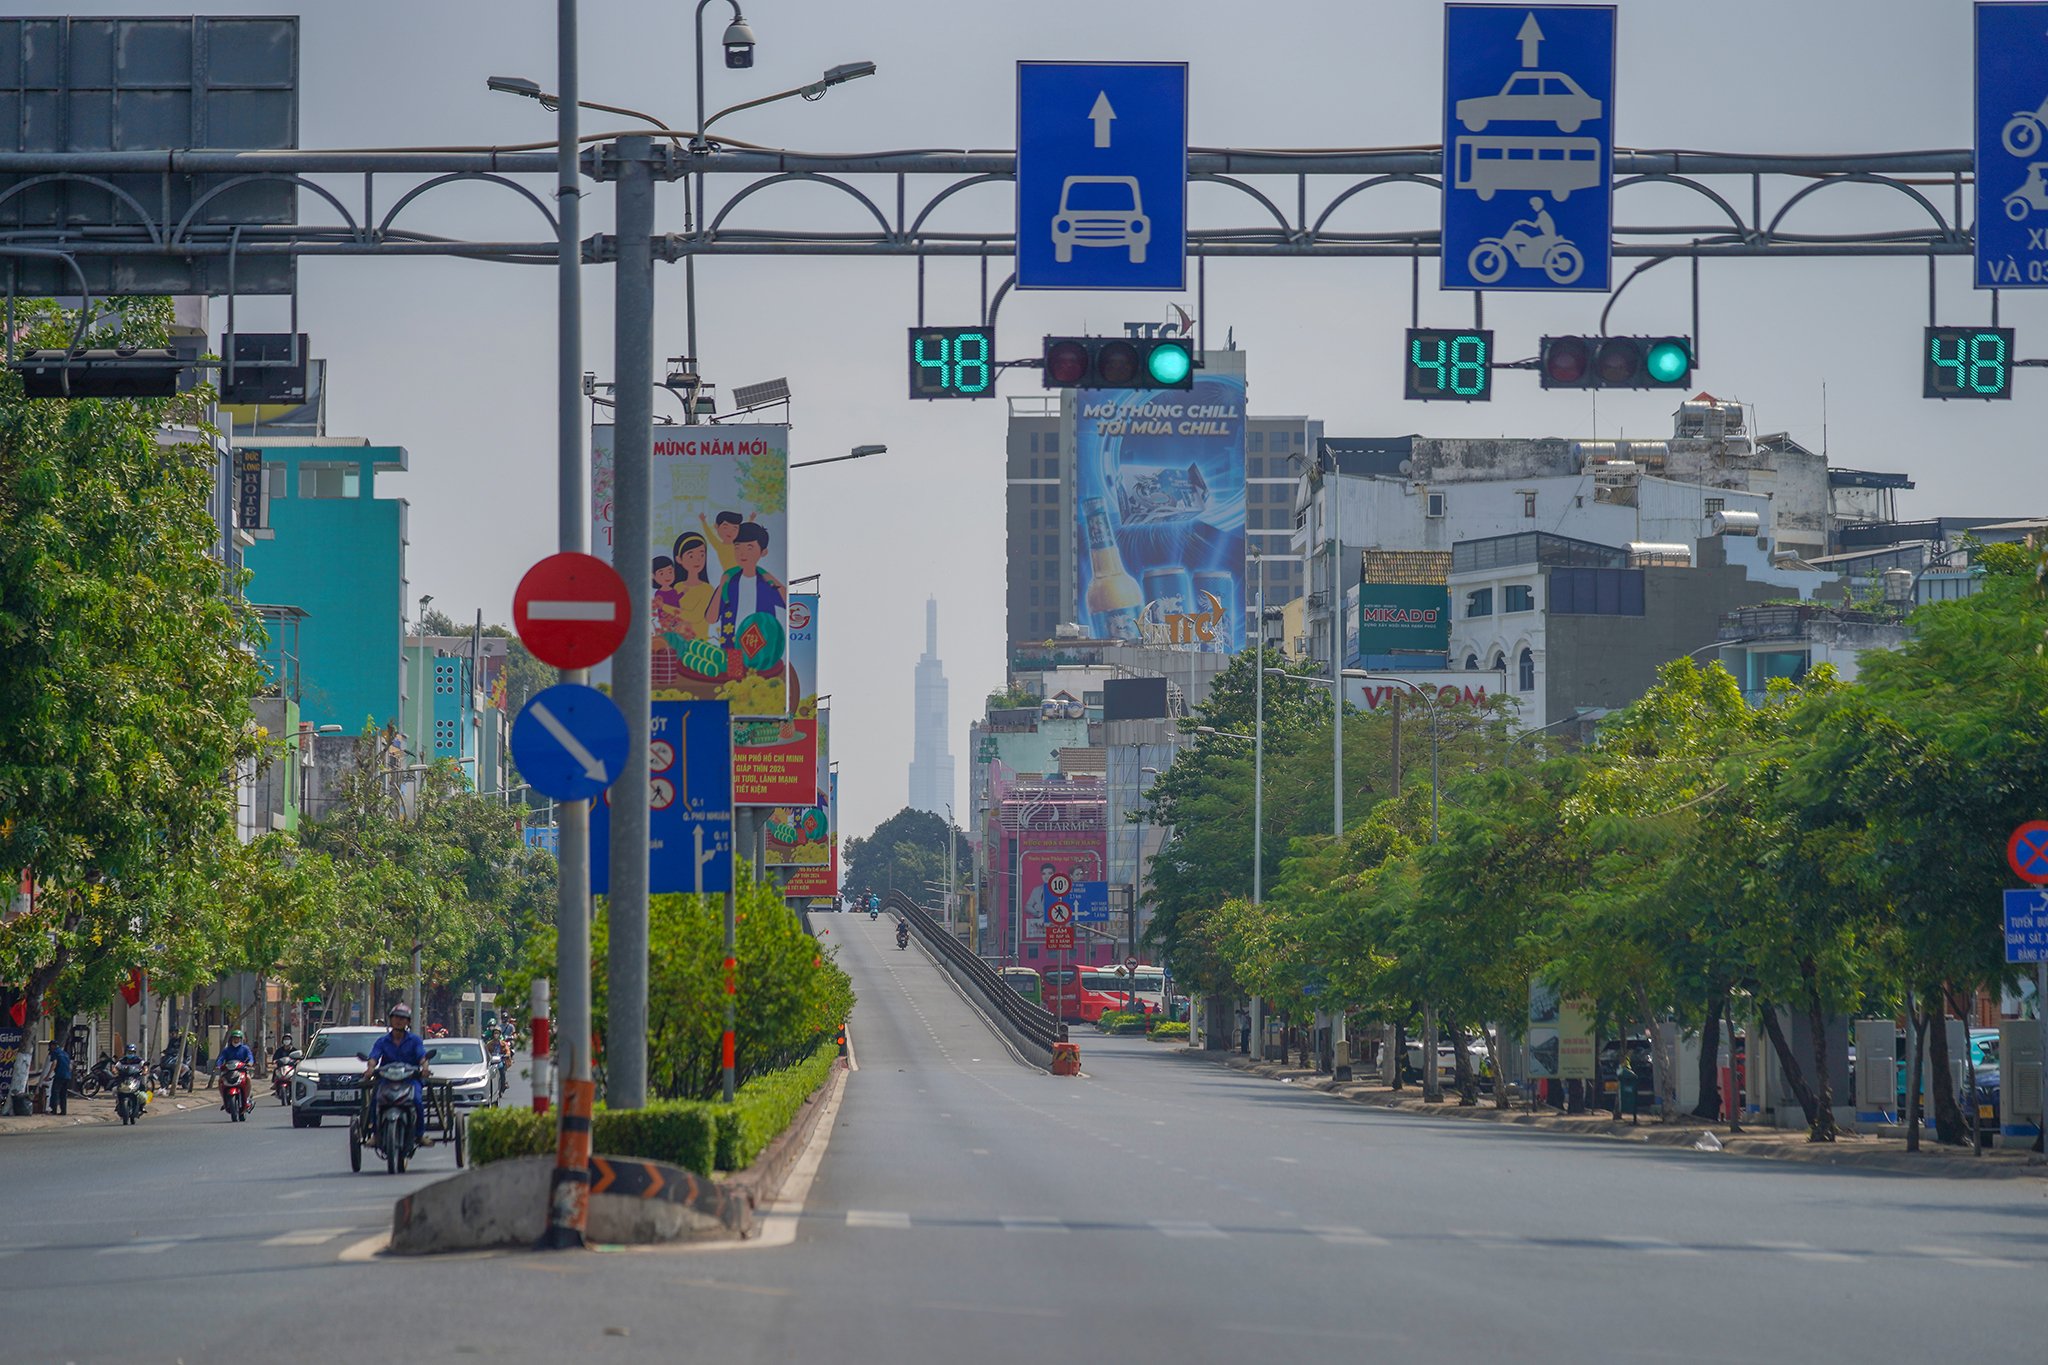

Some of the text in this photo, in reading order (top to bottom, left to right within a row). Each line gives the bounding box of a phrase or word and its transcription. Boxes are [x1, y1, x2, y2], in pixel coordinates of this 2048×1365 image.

[2027, 228, 2048, 250] X
[1987, 254, 2022, 282] VÀ
[914, 333, 989, 393] 48
[1412, 336, 1485, 395] 48
[1931, 334, 2005, 393] 48
[1083, 400, 1239, 418] MỞ THÙNG CHILL
[1097, 418, 1231, 436] TỚI MÙA CHILL
[653, 436, 768, 456] MỪNG NĂM MỚI
[244, 473, 258, 528] HOTEL
[1364, 608, 1437, 622] MIKADO
[789, 633, 811, 641] 024
[1165, 613, 1217, 643] TTC
